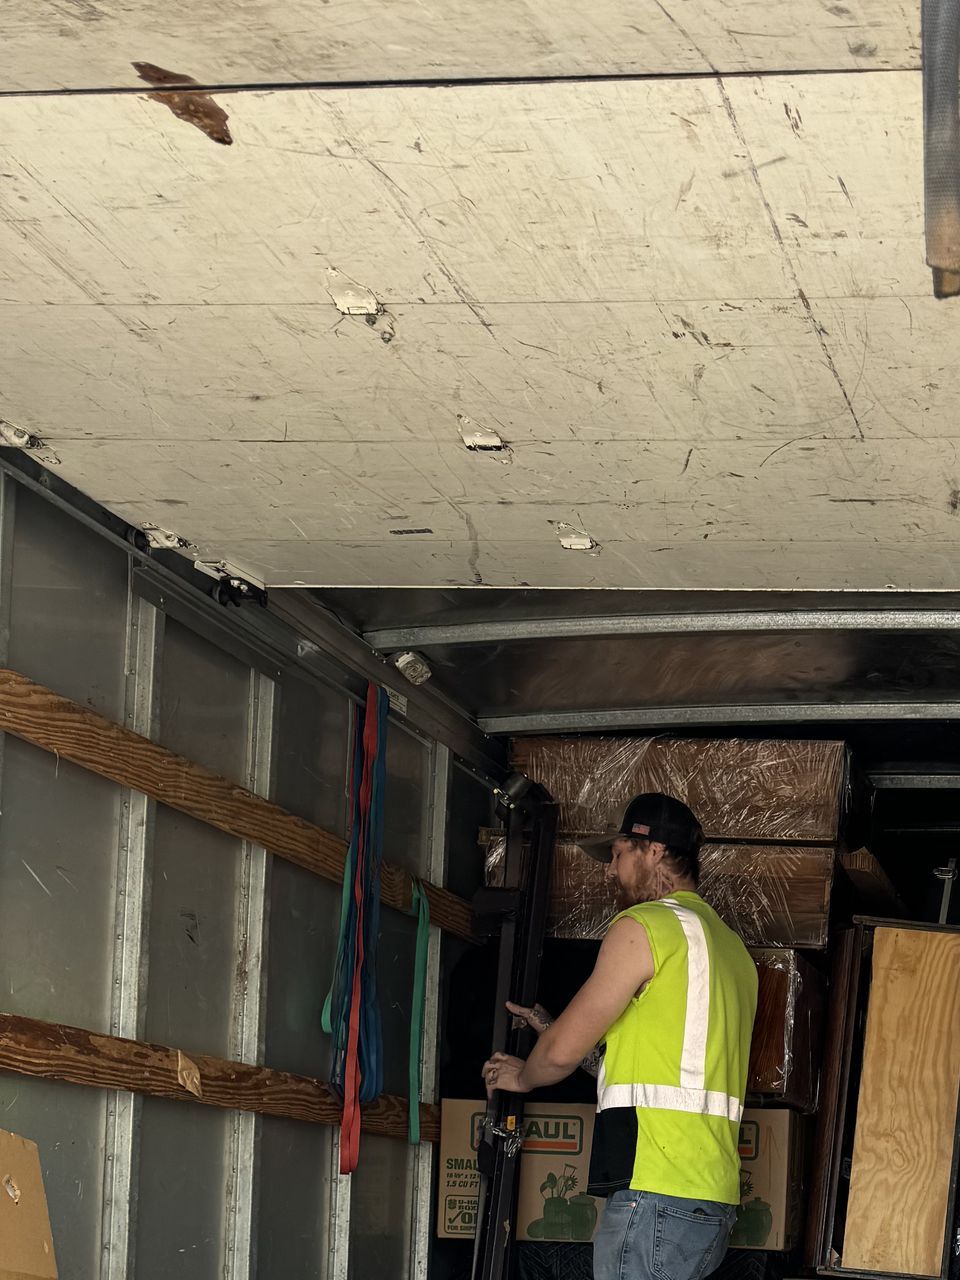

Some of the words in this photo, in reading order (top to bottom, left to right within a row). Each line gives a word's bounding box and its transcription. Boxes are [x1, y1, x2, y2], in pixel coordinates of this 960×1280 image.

[525, 1121, 576, 1140] AUL
[446, 1158, 478, 1171] SMAL
[446, 1180, 457, 1188] 1.5
